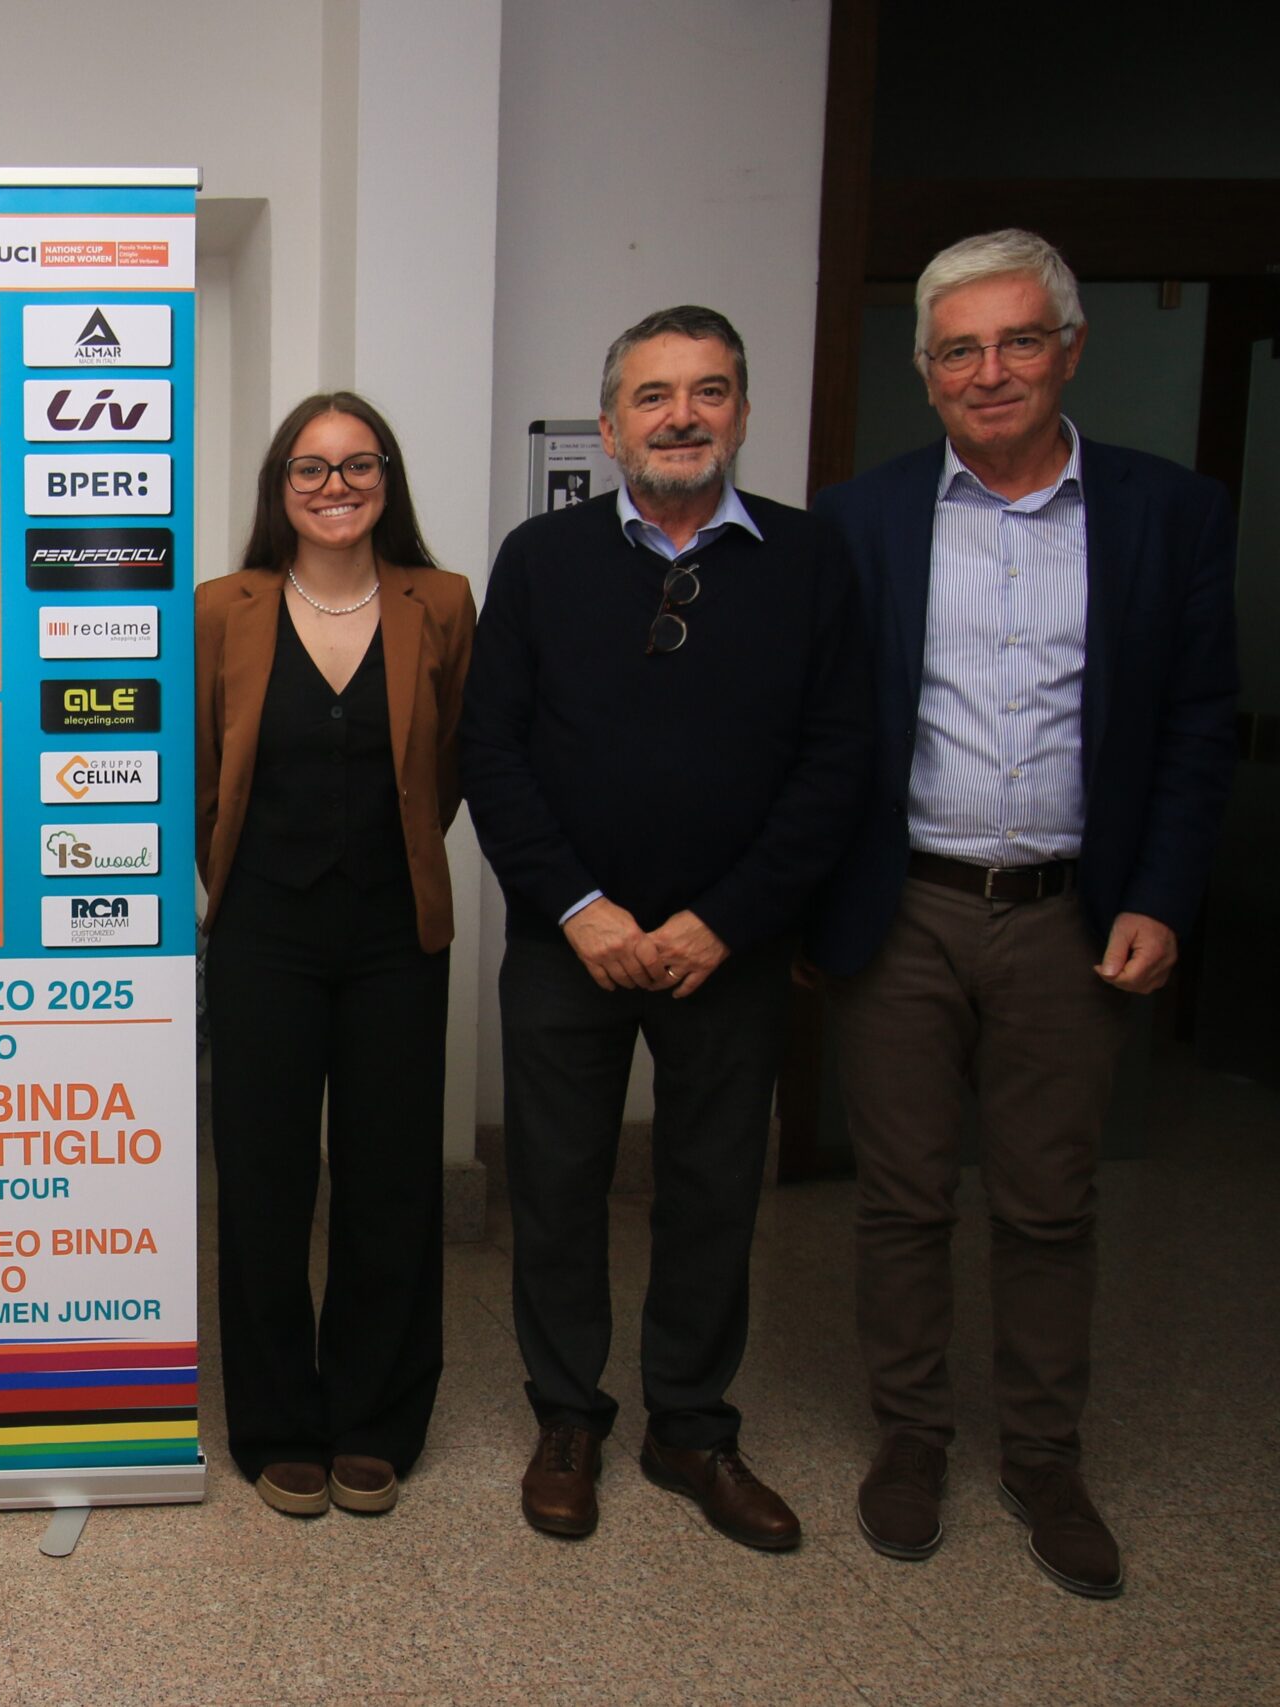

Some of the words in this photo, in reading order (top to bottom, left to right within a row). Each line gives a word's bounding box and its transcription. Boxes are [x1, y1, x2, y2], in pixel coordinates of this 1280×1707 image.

[86, 246, 103, 254] CUP
[45, 255, 76, 263] JUNIOR
[76, 255, 112, 263] WOMEN
[74, 347, 122, 358] ALMAR
[47, 389, 149, 431] Liv
[32, 548, 167, 562] PERUFFOCICLI
[73, 622, 151, 636] reclame
[64, 716, 135, 726] alecycling.com
[90, 760, 143, 769] GRUPPO
[73, 770, 142, 785] CELLINA
[58, 843, 93, 869] IS
[94, 847, 150, 868] wood
[71, 897, 129, 918] RCA
[71, 918, 129, 929] BIGNAMI
[47, 979, 135, 1011] 2025
[51, 1227, 158, 1255] BINDA
[58, 1299, 161, 1323] JUNIOR
